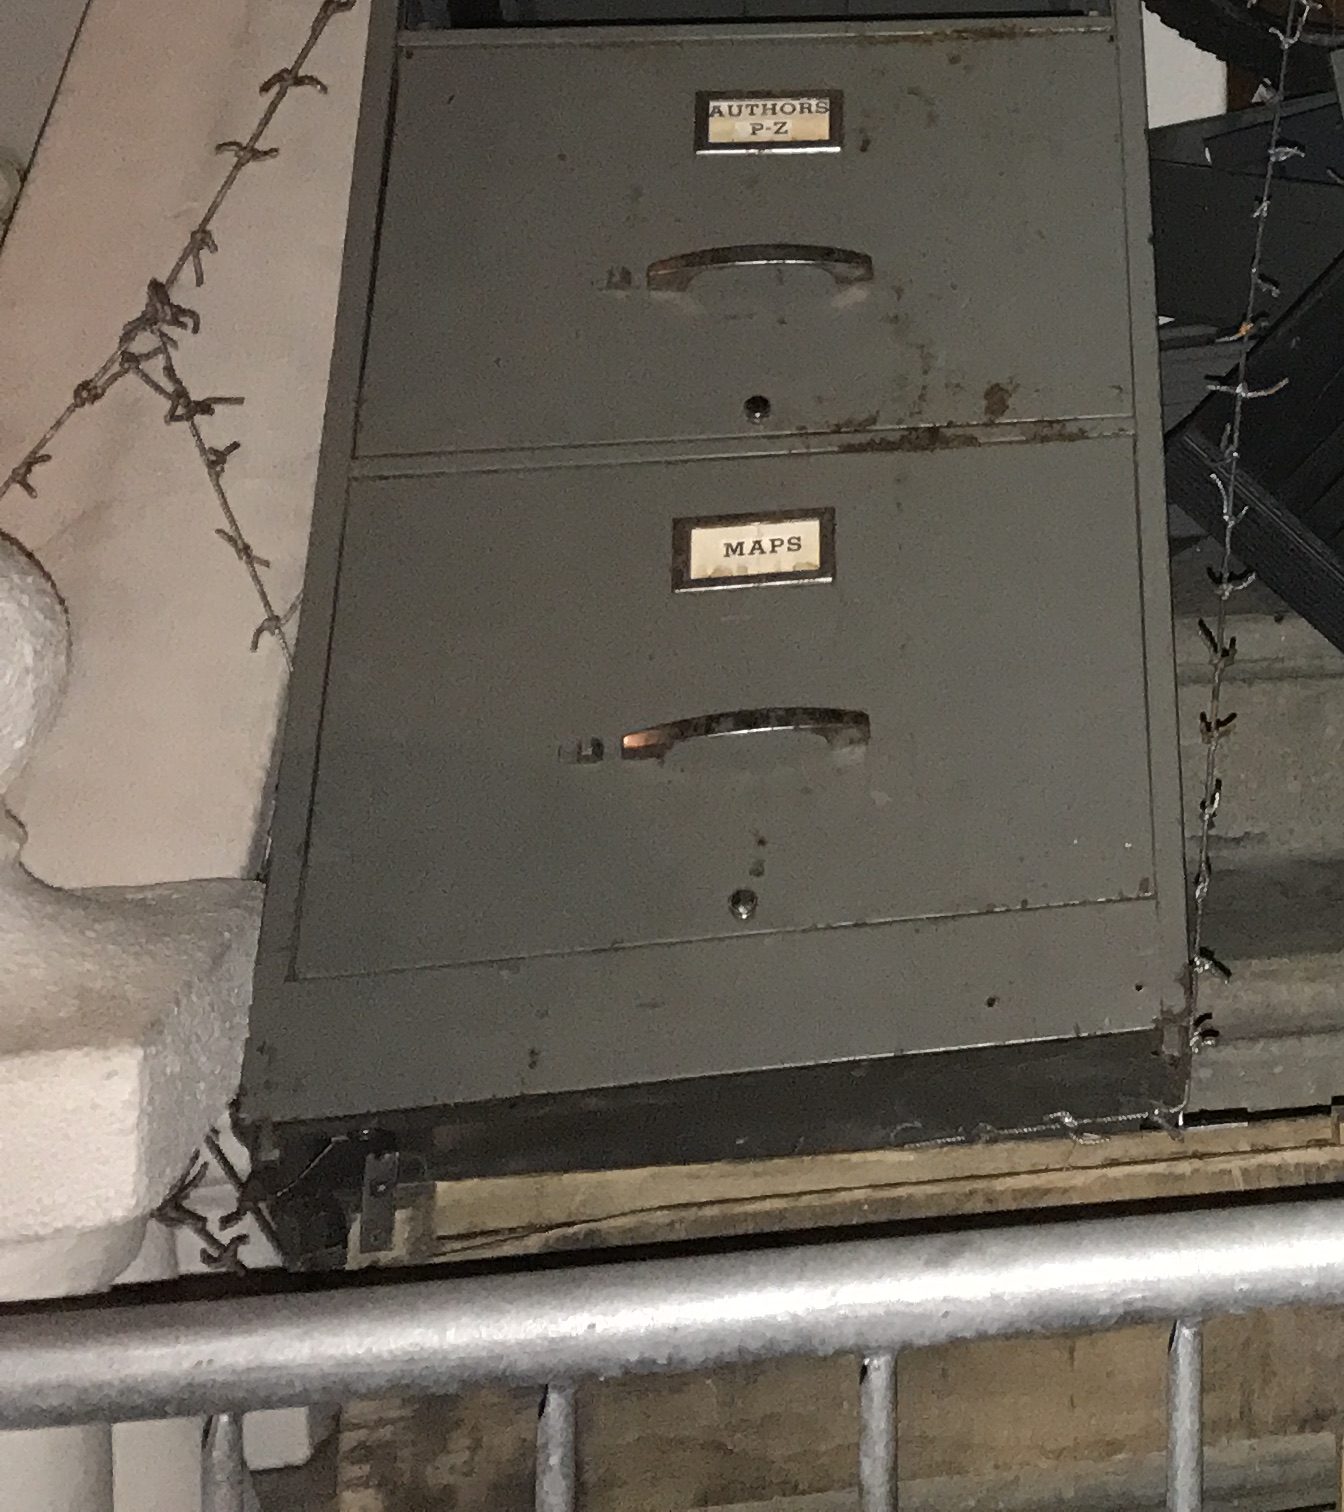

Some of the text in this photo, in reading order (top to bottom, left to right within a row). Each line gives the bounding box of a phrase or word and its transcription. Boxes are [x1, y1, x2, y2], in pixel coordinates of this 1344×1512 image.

[709, 101, 830, 118] AUTHORS
[749, 121, 789, 136] P-Z
[723, 535, 803, 558] MAPS
